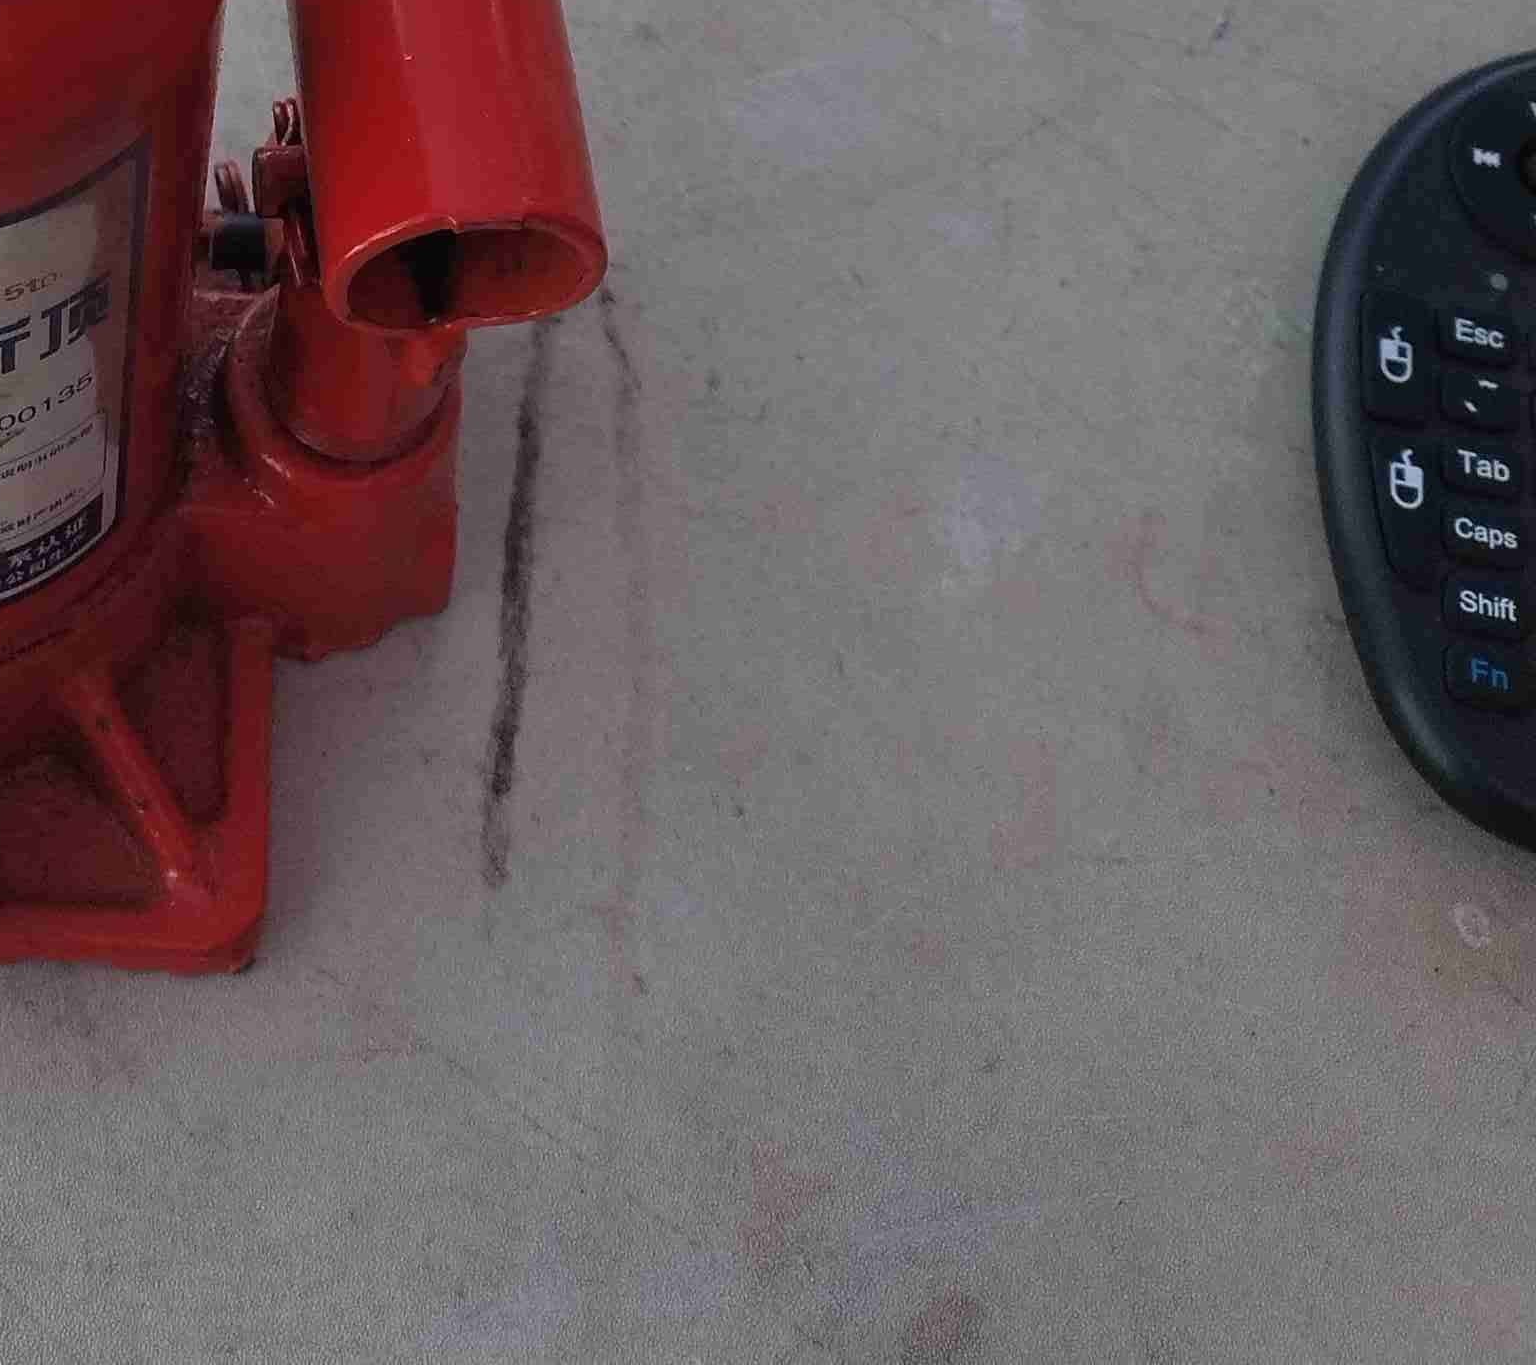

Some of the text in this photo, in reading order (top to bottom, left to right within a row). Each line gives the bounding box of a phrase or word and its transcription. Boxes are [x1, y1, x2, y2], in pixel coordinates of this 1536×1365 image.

[1454, 316, 1505, 349] Esc
[1457, 448, 1511, 482] Tab
[1454, 517, 1519, 550] Caps
[1459, 588, 1518, 622] Shift
[1471, 655, 1510, 693] Fn
